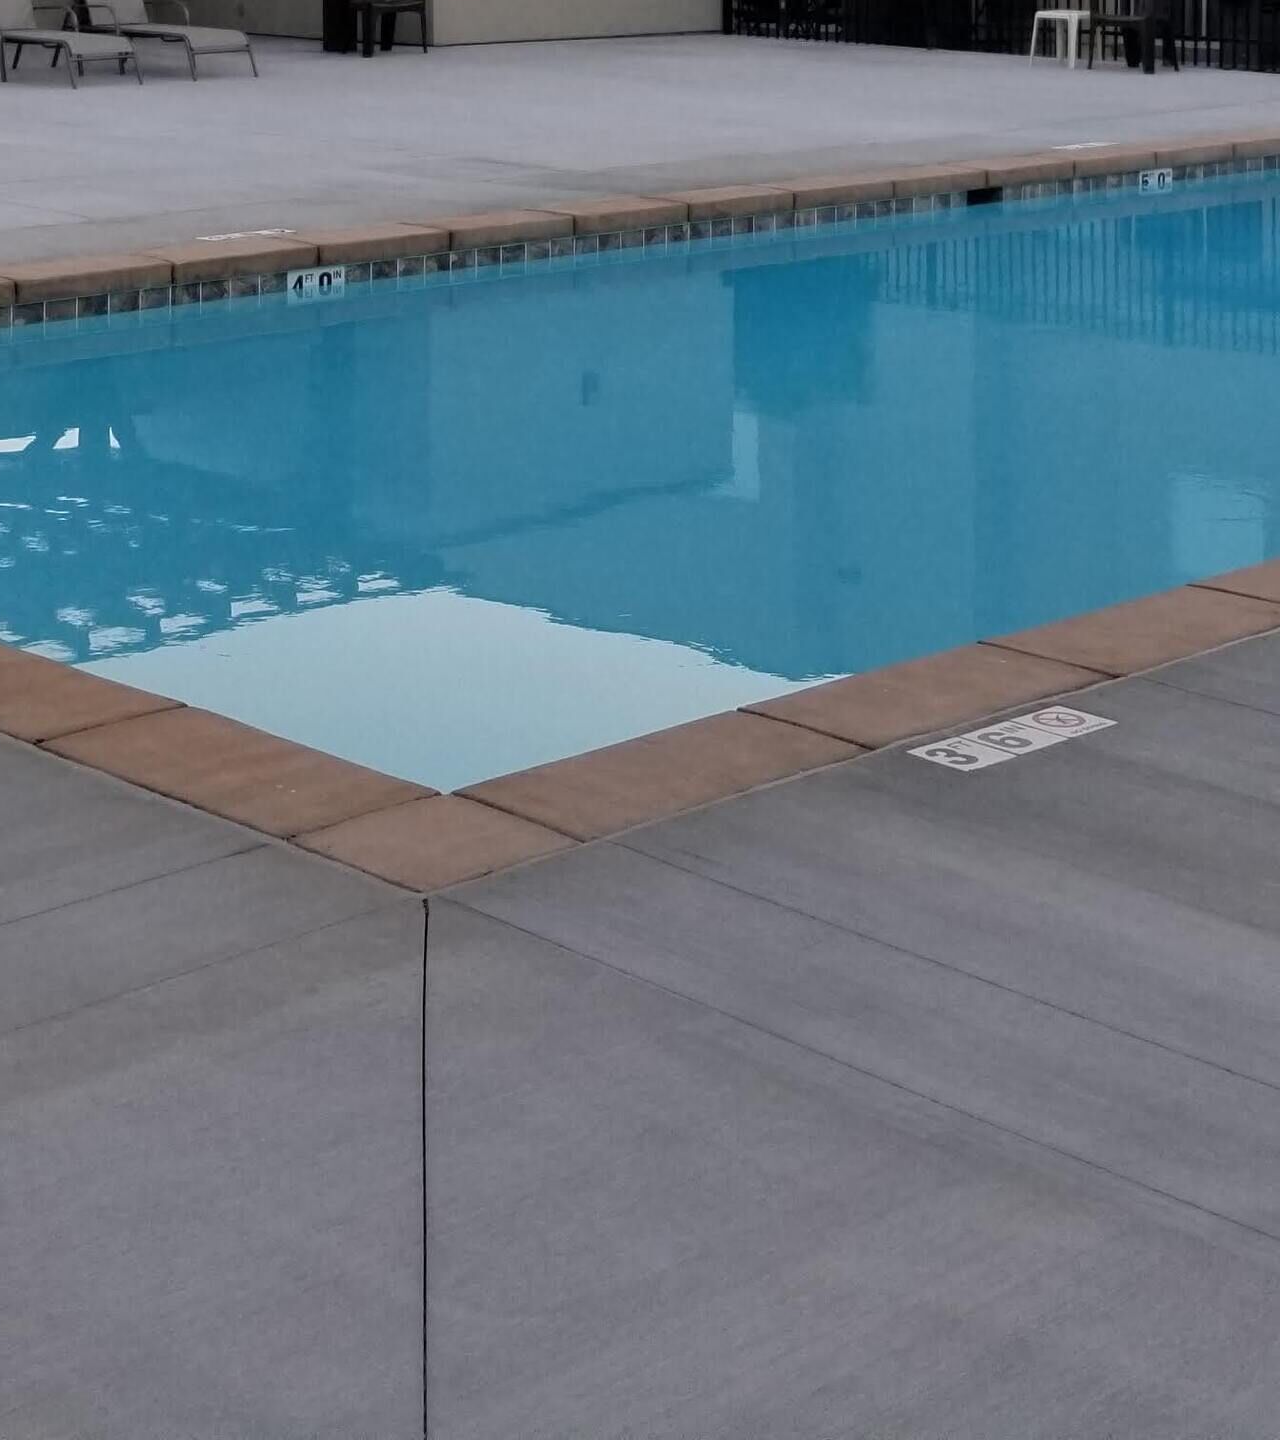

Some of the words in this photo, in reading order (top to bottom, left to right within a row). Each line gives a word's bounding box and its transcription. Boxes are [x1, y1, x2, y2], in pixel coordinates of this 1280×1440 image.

[292, 274, 304, 290] 4
[305, 273, 314, 284] FT
[318, 271, 332, 288] 0
[333, 270, 342, 280] IN
[947, 740, 974, 751] FT
[976, 731, 1034, 750] 6
[925, 748, 980, 766] 3
